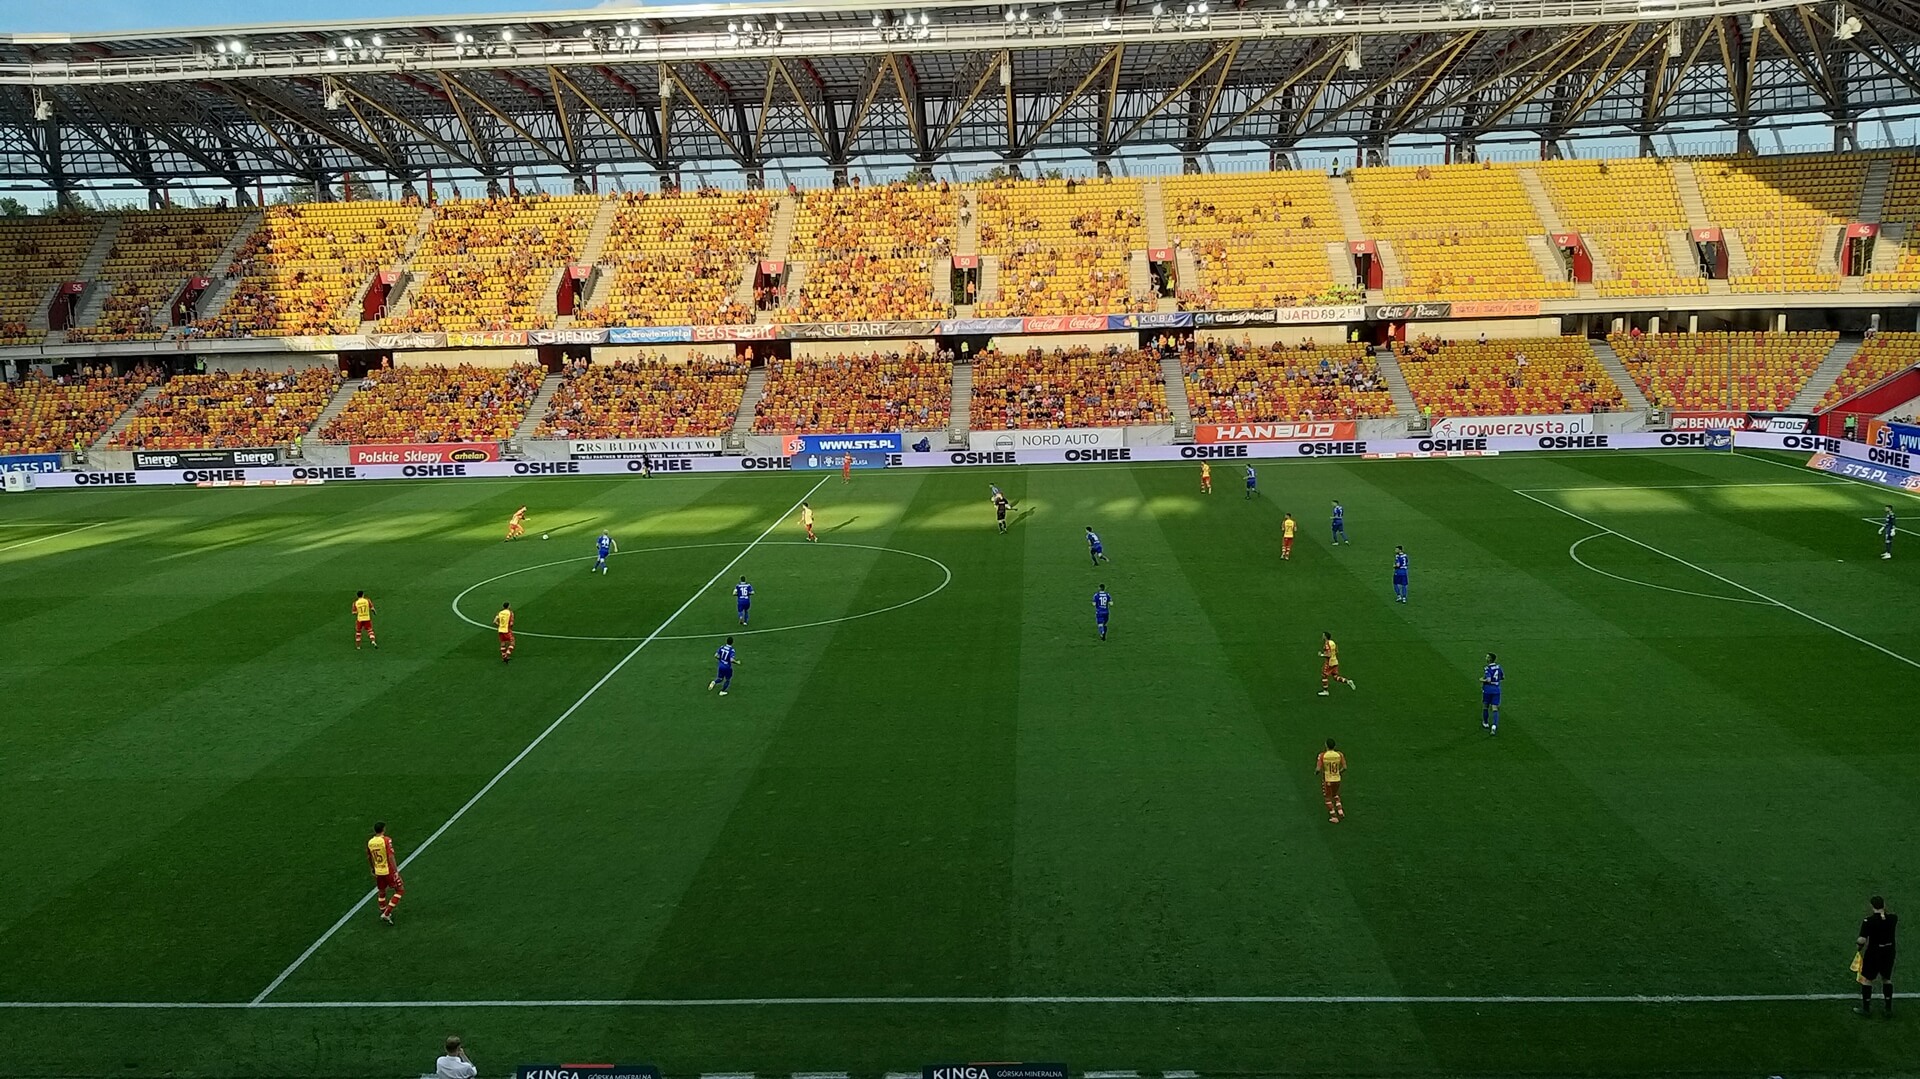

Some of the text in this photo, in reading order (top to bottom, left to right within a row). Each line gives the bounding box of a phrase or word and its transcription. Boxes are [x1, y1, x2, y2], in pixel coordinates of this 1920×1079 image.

[1195, 313, 1214, 325] GM
[557, 331, 601, 343] HELIOS
[1460, 419, 1585, 438] rowerzysta.pl
[1689, 417, 1744, 429] BENMAR
[1751, 420, 1805, 430] AW TOOLS
[1216, 424, 1335, 440] HANBUD
[586, 439, 715, 453] RS BUDOWNICTWO
[788, 439, 805, 452] STS
[819, 440, 895, 451] WWW.STS.PL
[1022, 434, 1061, 446] NORD
[1064, 433, 1099, 445] AUTO
[1419, 439, 1487, 451] OSHEE
[1539, 435, 1608, 448] OSHEE
[1783, 436, 1841, 454] OSHEE
[1065, 448, 1131, 461] OSHEE
[1181, 445, 1248, 458] OSHEE
[1299, 442, 1367, 455] OSHEE
[137, 454, 178, 467] Energo
[234, 451, 275, 465] Energo
[358, 450, 443, 464] Polskie Sklepy
[951, 452, 1016, 464] OSHEE
[1868, 447, 1911, 468] OSHEE
[293, 467, 357, 479] OSHEE
[403, 464, 467, 477] OSHEE
[514, 461, 581, 474] OSHEE
[1843, 463, 1888, 483] STS.PL
[75, 473, 137, 484] OSHEE
[183, 470, 247, 482] OSHEE
[526, 1069, 580, 1079] KINGA
[933, 1067, 1063, 1079] KINGA GÓRSKA MINERALNA
